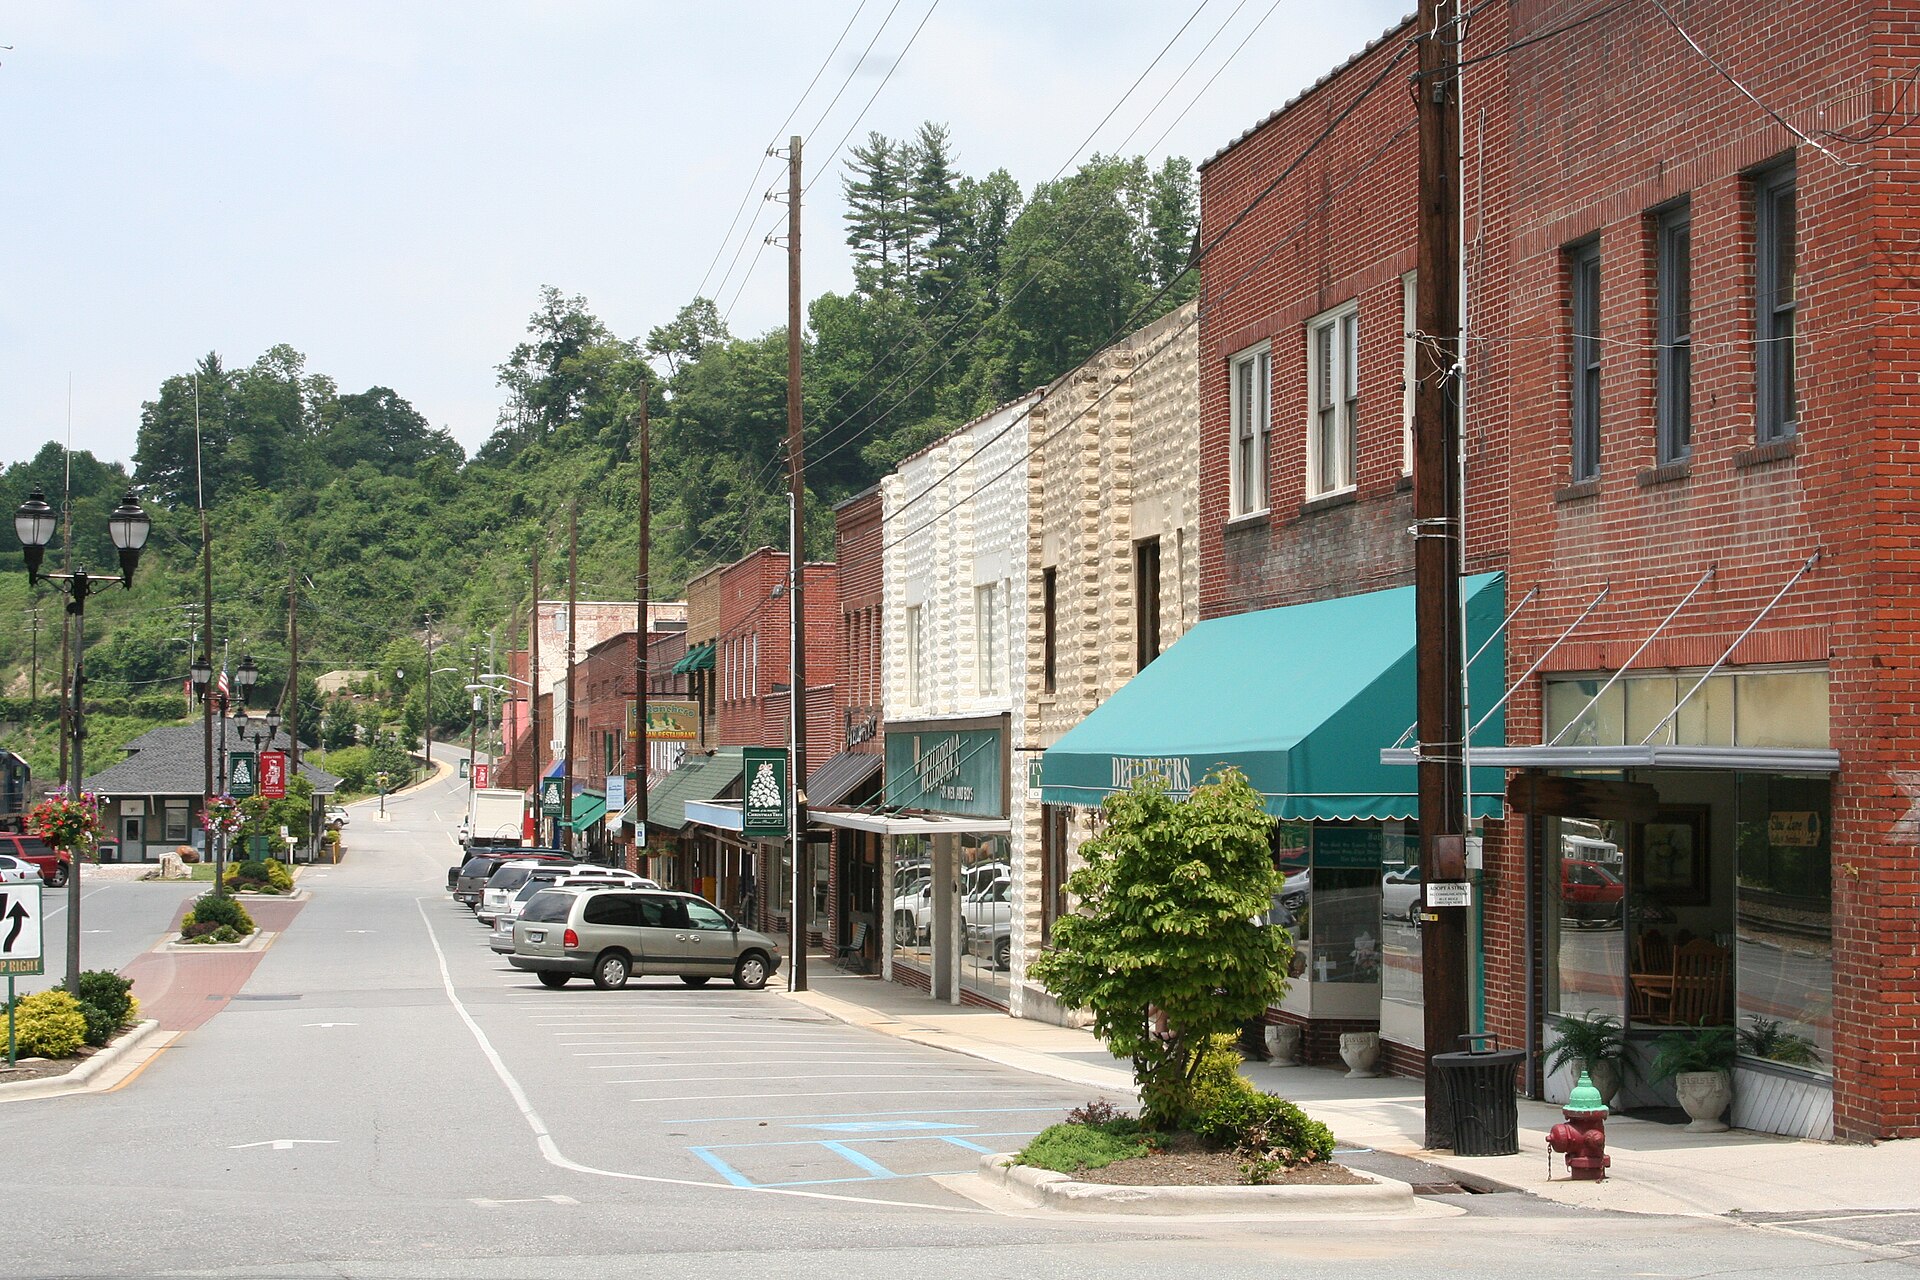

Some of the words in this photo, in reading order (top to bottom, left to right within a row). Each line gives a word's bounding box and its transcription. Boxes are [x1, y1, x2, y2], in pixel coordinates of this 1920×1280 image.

[658, 730, 697, 739] RESTAURANT
[947, 786, 955, 800] MEN
[9, 959, 39, 972] RIGHT
